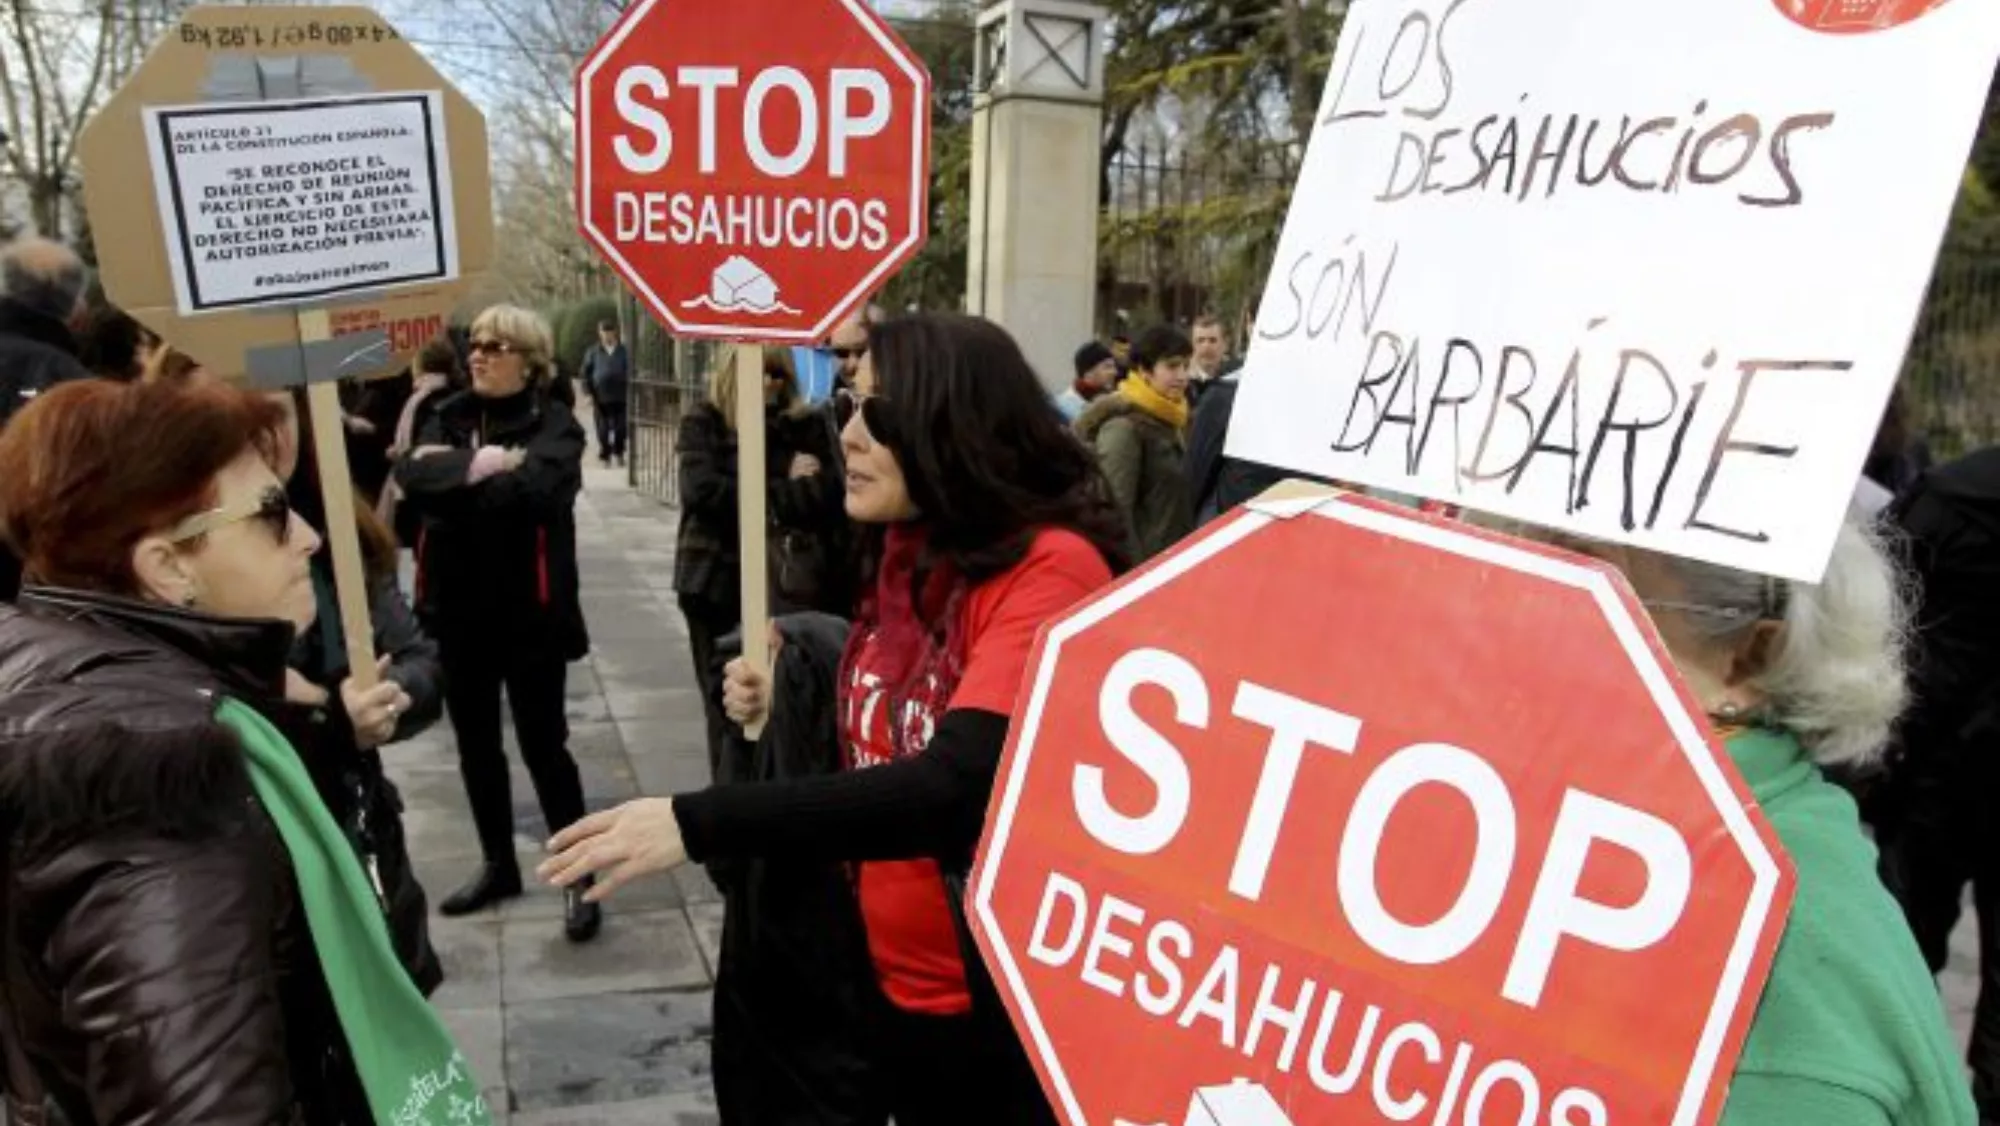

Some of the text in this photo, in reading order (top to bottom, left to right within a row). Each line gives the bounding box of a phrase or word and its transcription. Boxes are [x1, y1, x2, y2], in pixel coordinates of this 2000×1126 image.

[1322, 0, 1468, 126] LOS
[611, 64, 893, 178] STOP
[176, 142, 197, 155] DE
[200, 140, 221, 153] LA
[261, 156, 361, 178] RECONOCE
[366, 154, 386, 168] EL
[203, 179, 295, 199] DERECHO
[300, 176, 324, 190] DE
[294, 194, 308, 206] Y
[312, 191, 345, 205] SIN
[215, 196, 409, 230] EL EJERCICIO DE ESTE
[614, 191, 888, 251] DESAHUCIOS
[194, 227, 285, 248] DERECHO
[291, 224, 318, 238] NO
[1072, 646, 1694, 1009] STOP
